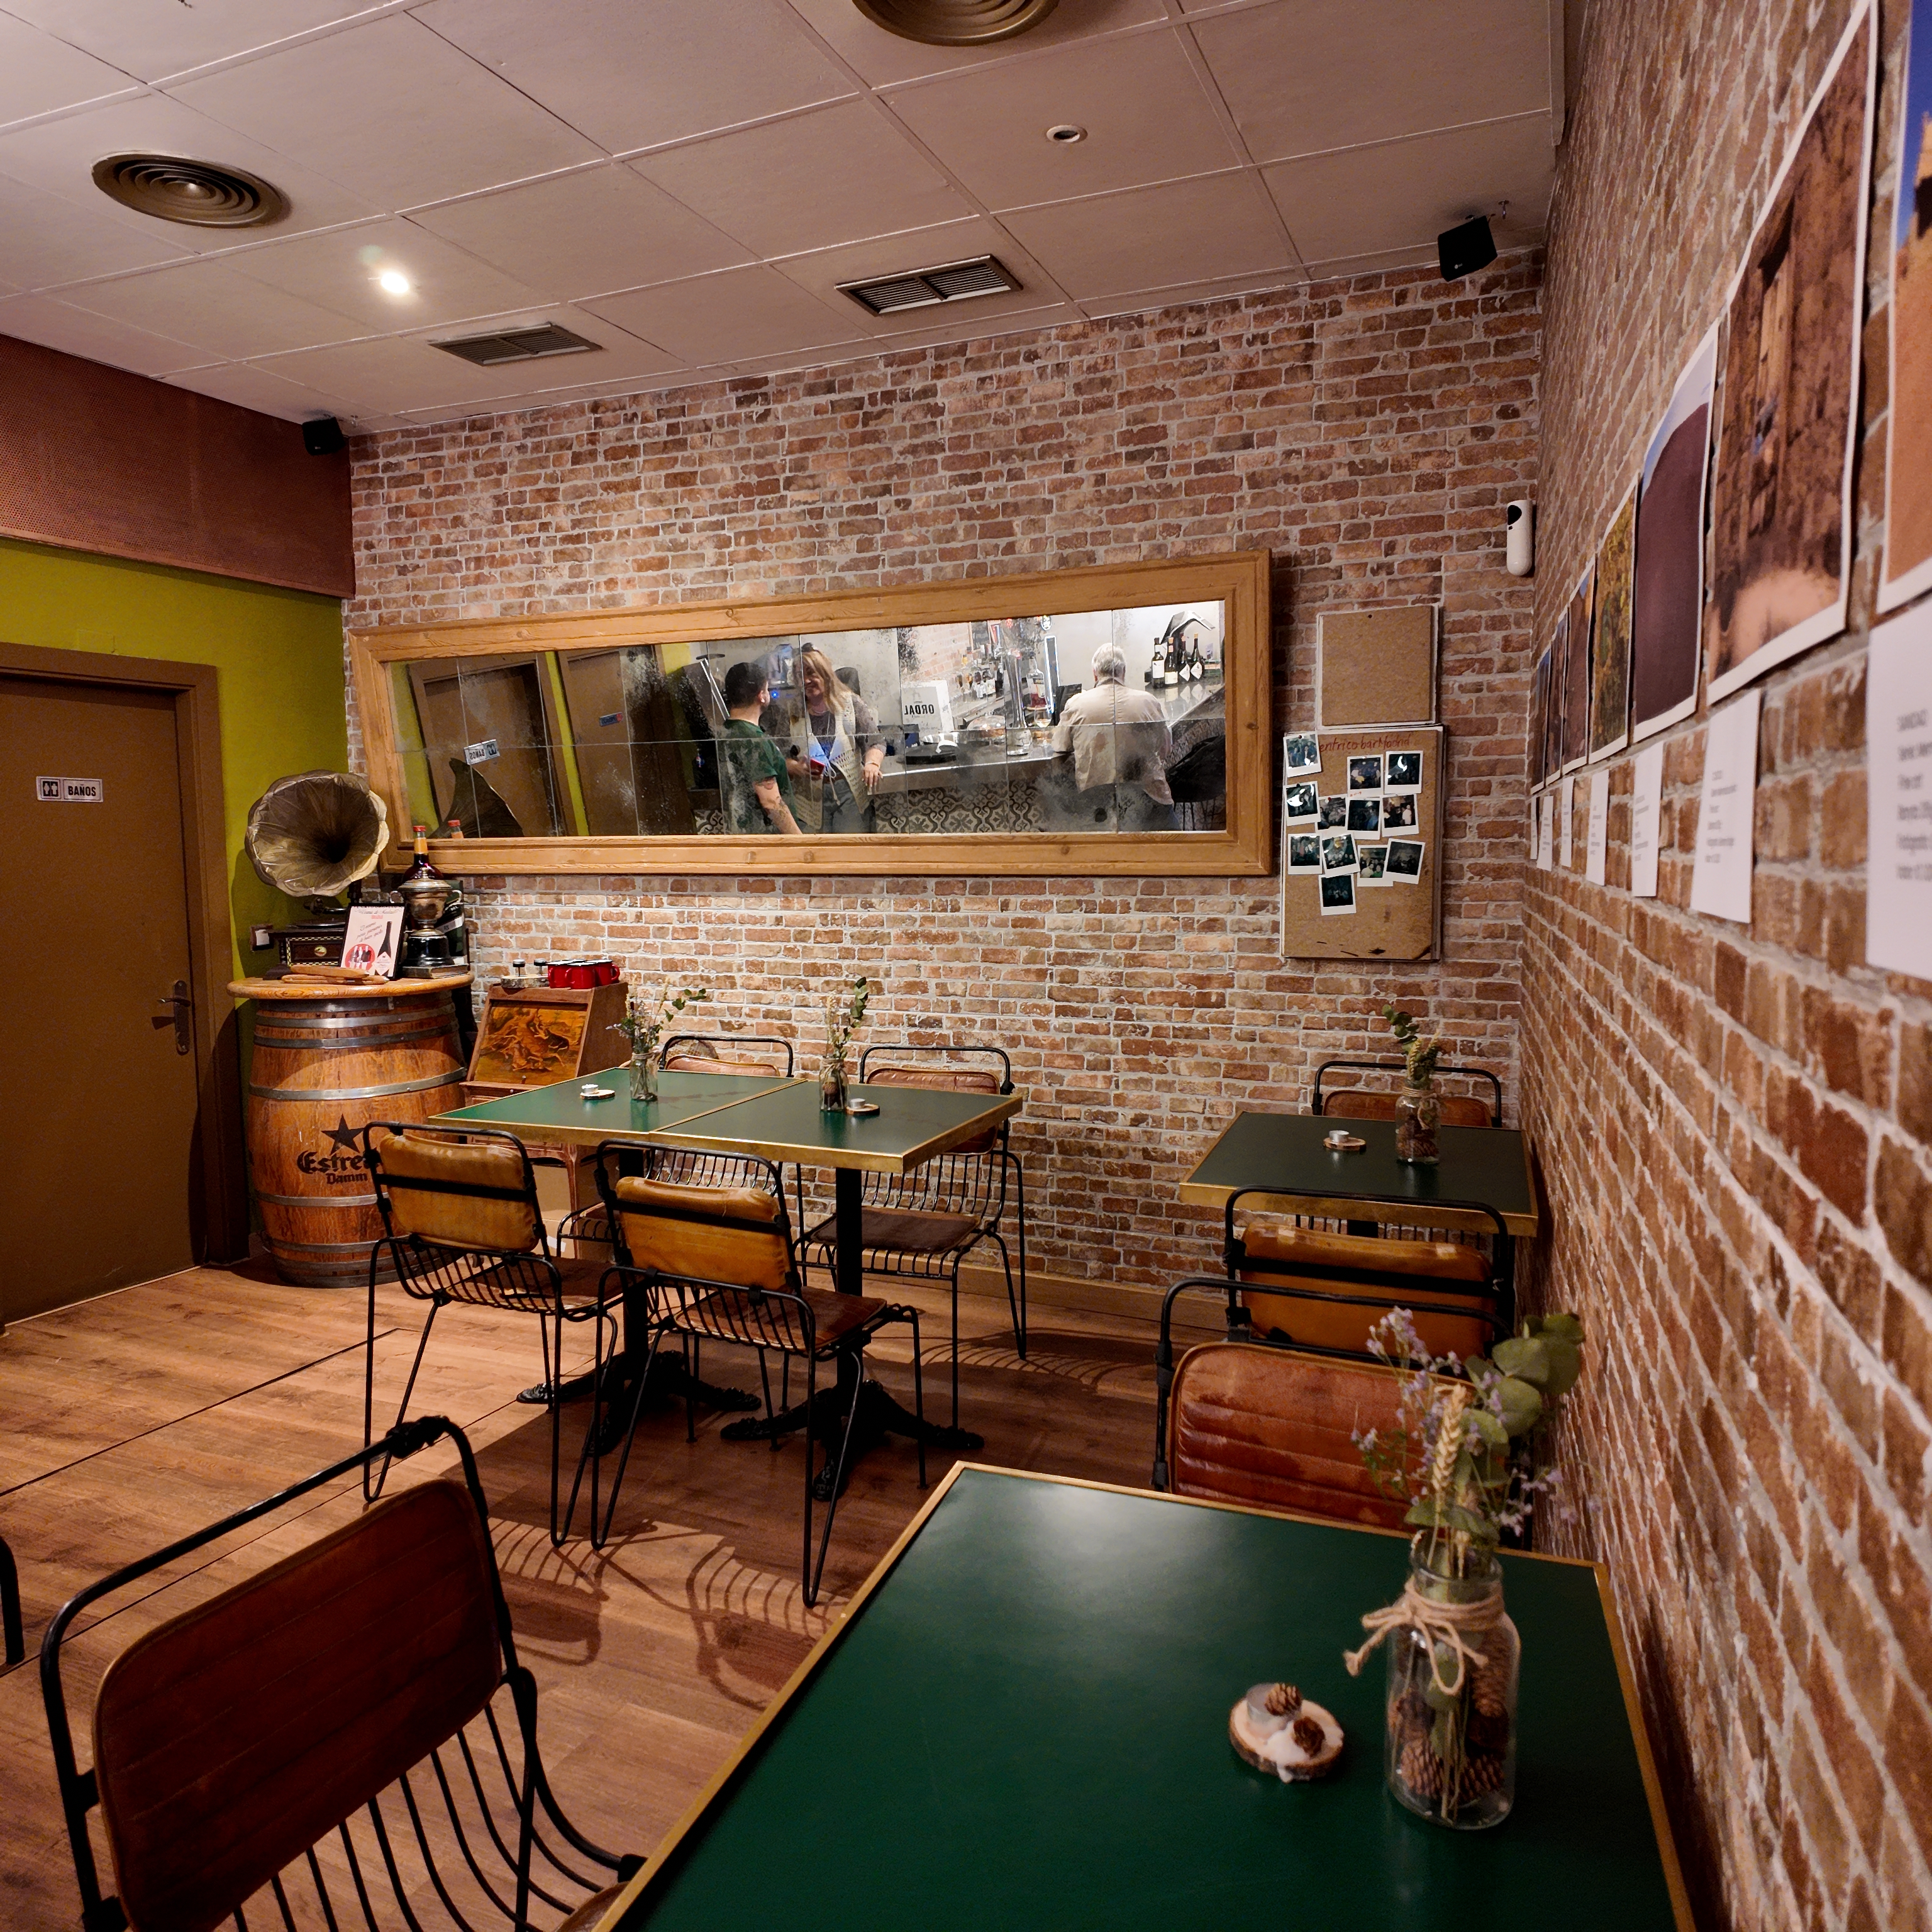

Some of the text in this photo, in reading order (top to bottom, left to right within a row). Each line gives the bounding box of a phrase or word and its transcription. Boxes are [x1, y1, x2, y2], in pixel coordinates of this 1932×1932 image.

[67, 784, 96, 797] BAÑOS
[297, 1150, 377, 1174] Estre
[325, 1173, 368, 1185] Damm
